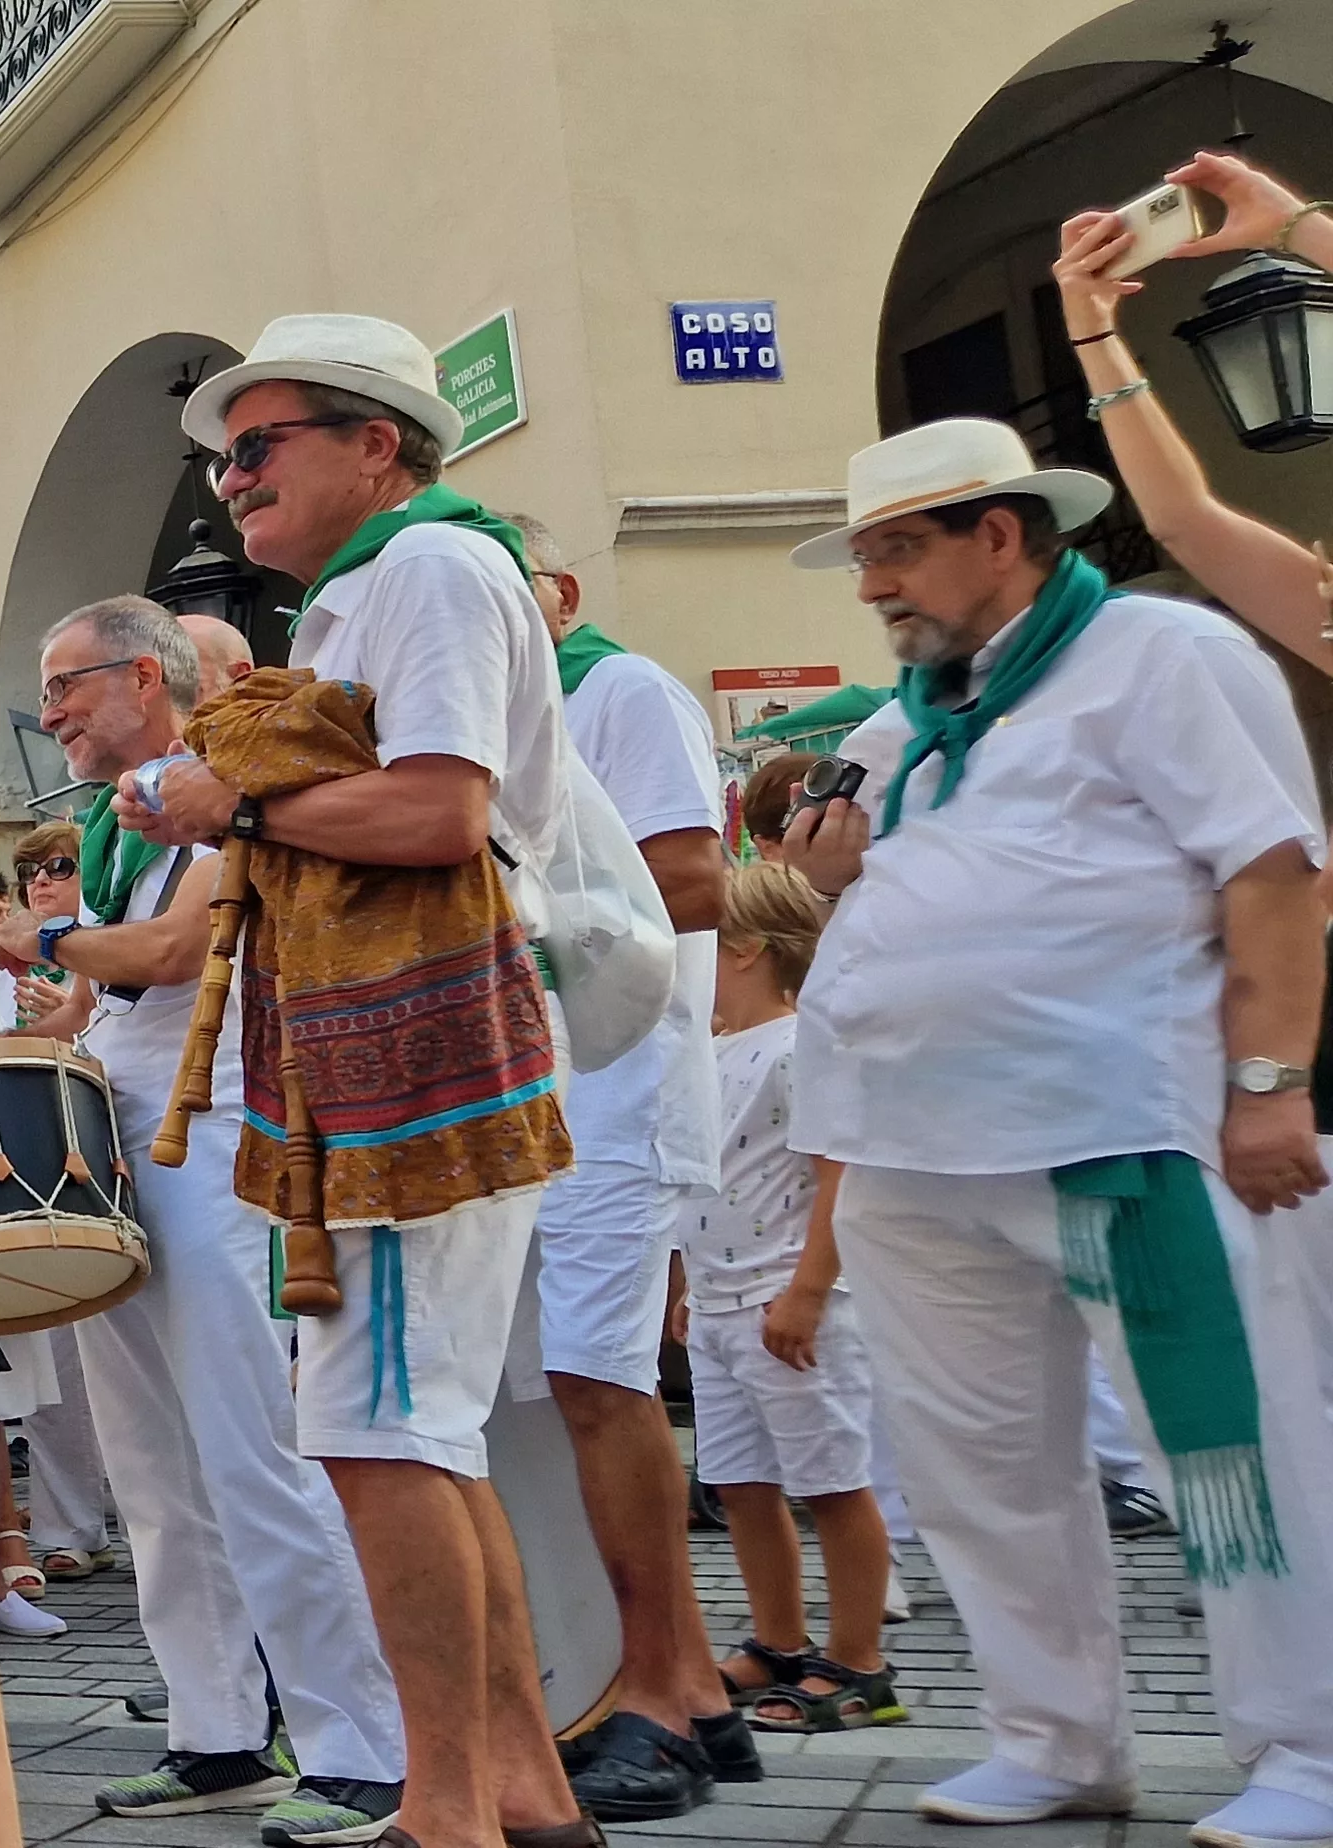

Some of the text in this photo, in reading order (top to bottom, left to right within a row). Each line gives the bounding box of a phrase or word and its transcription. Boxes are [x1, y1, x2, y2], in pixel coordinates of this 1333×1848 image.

[681, 312, 772, 334] COSO
[451, 353, 497, 391] PORCHES
[685, 347, 776, 370] ALTO
[456, 376, 497, 409] GALICIA
